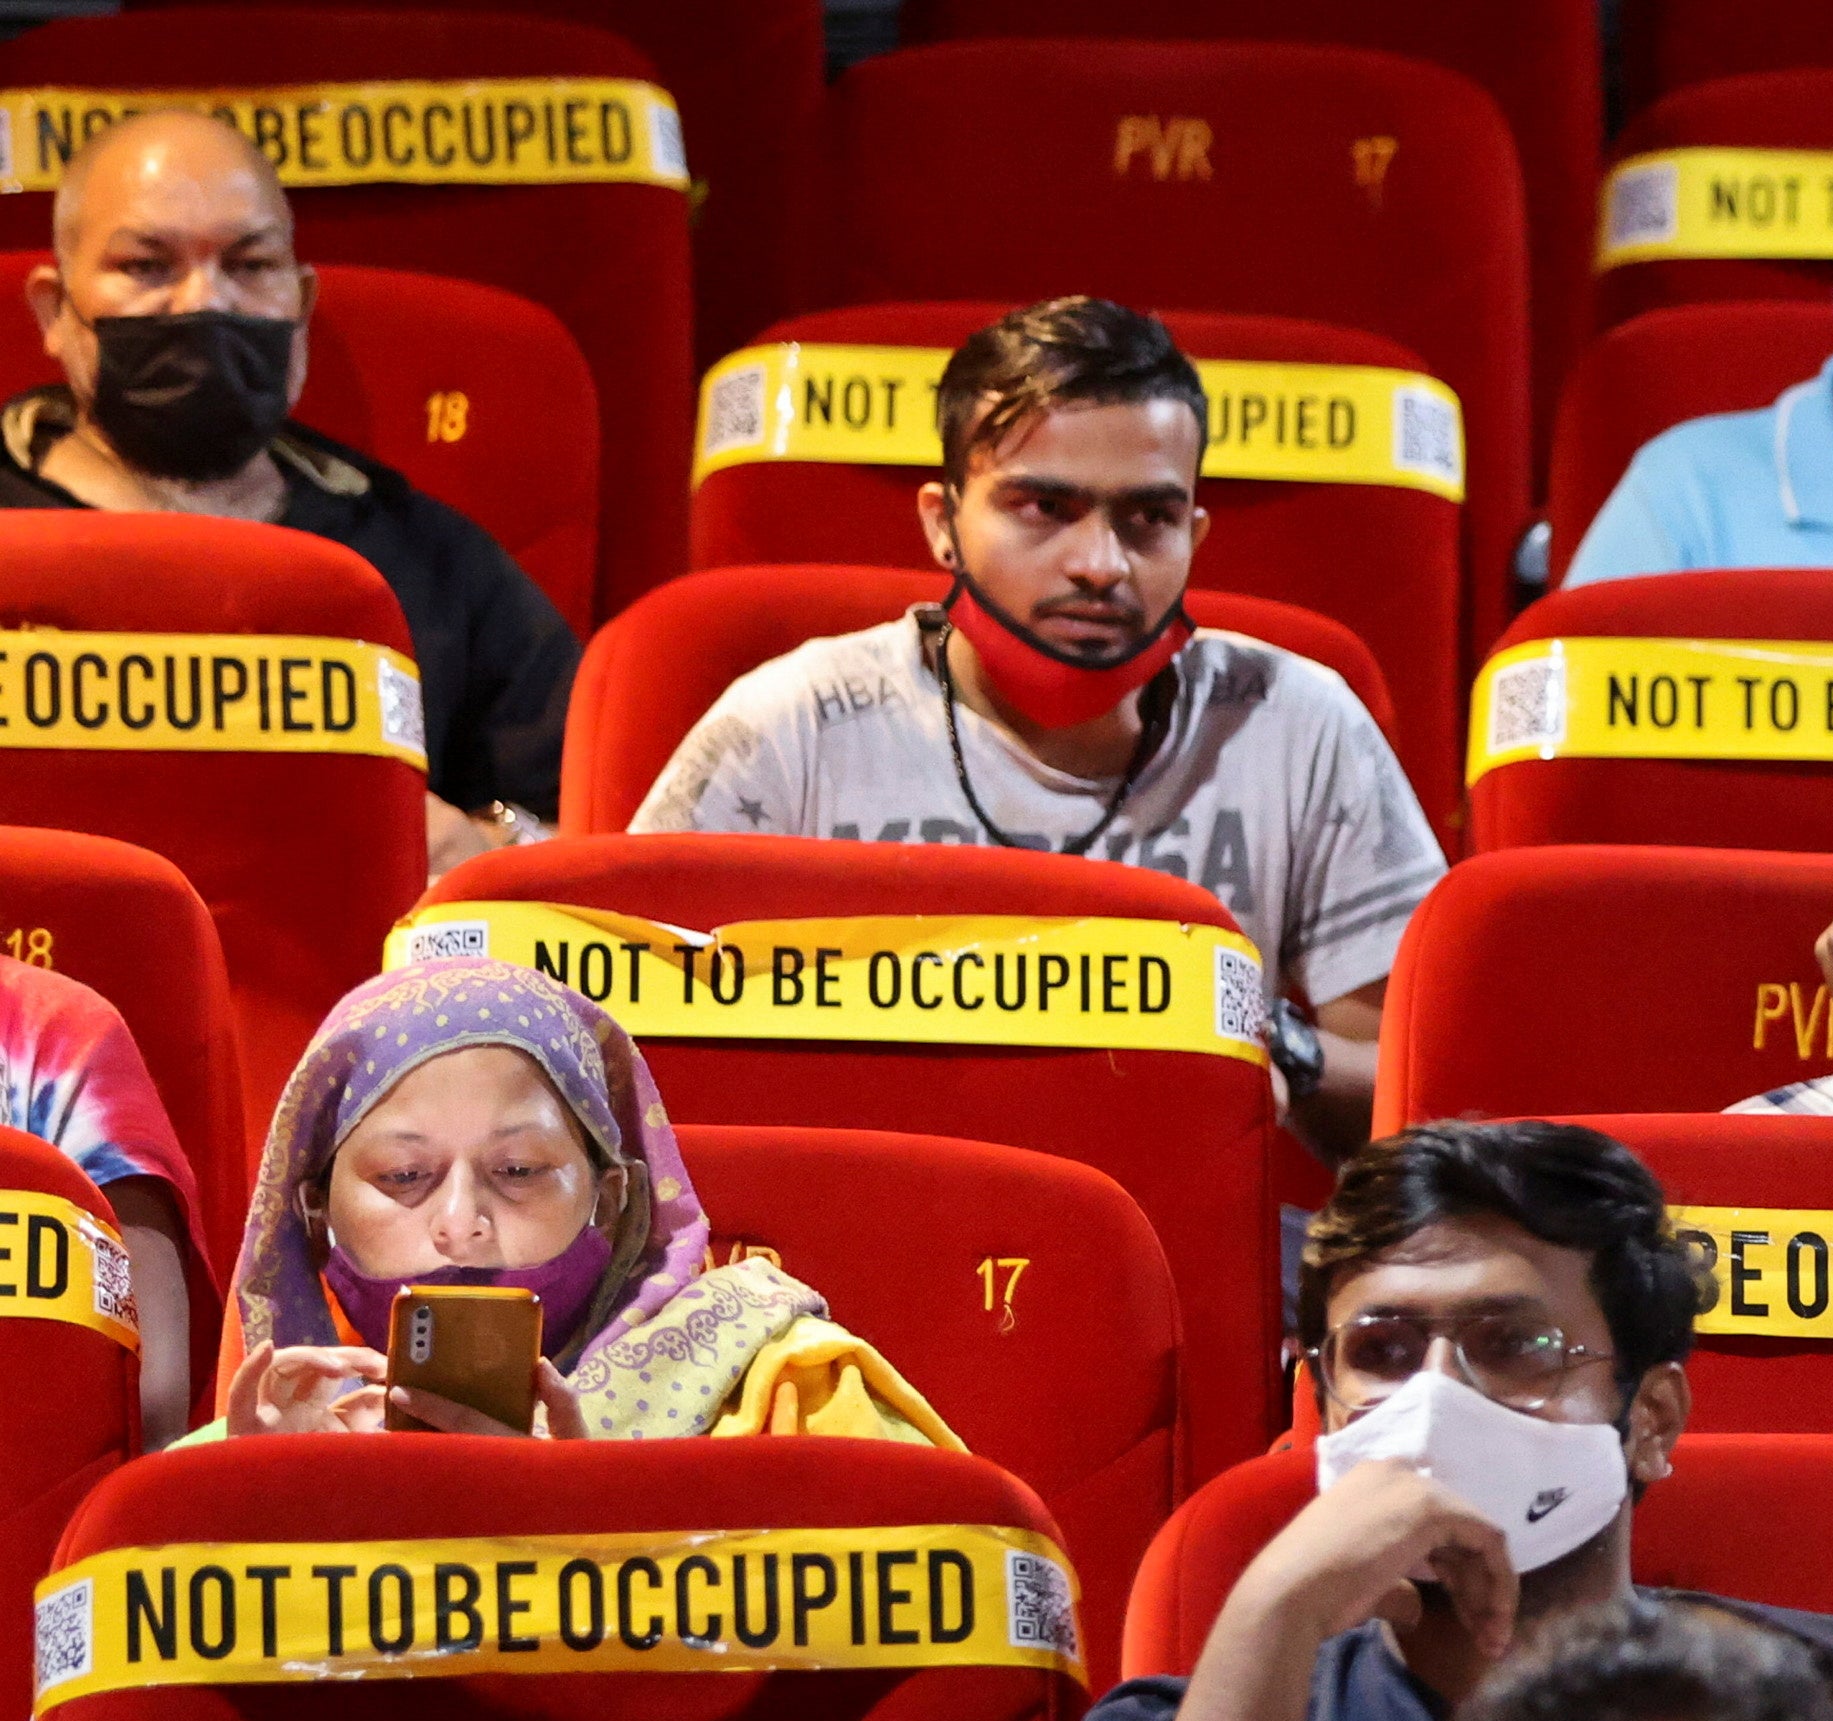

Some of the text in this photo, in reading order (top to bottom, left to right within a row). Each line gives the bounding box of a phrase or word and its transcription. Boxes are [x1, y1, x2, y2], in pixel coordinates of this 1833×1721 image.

[341, 99, 632, 168] OCCUPIED
[1709, 176, 1803, 222] NOT
[426, 394, 467, 443] 18
[804, 376, 902, 432] NOT
[1211, 395, 1355, 449] UPIED
[27, 653, 357, 734] OCCUPIED
[1607, 674, 1707, 729] NOT
[1737, 678, 1799, 731] TO
[5, 928, 53, 969] 18
[535, 940, 1171, 1013] NOT TO BE OCCUPIED
[977, 1258, 1029, 1310] 17
[127, 1550, 974, 1662] NOT TO BE OCCUPIED
